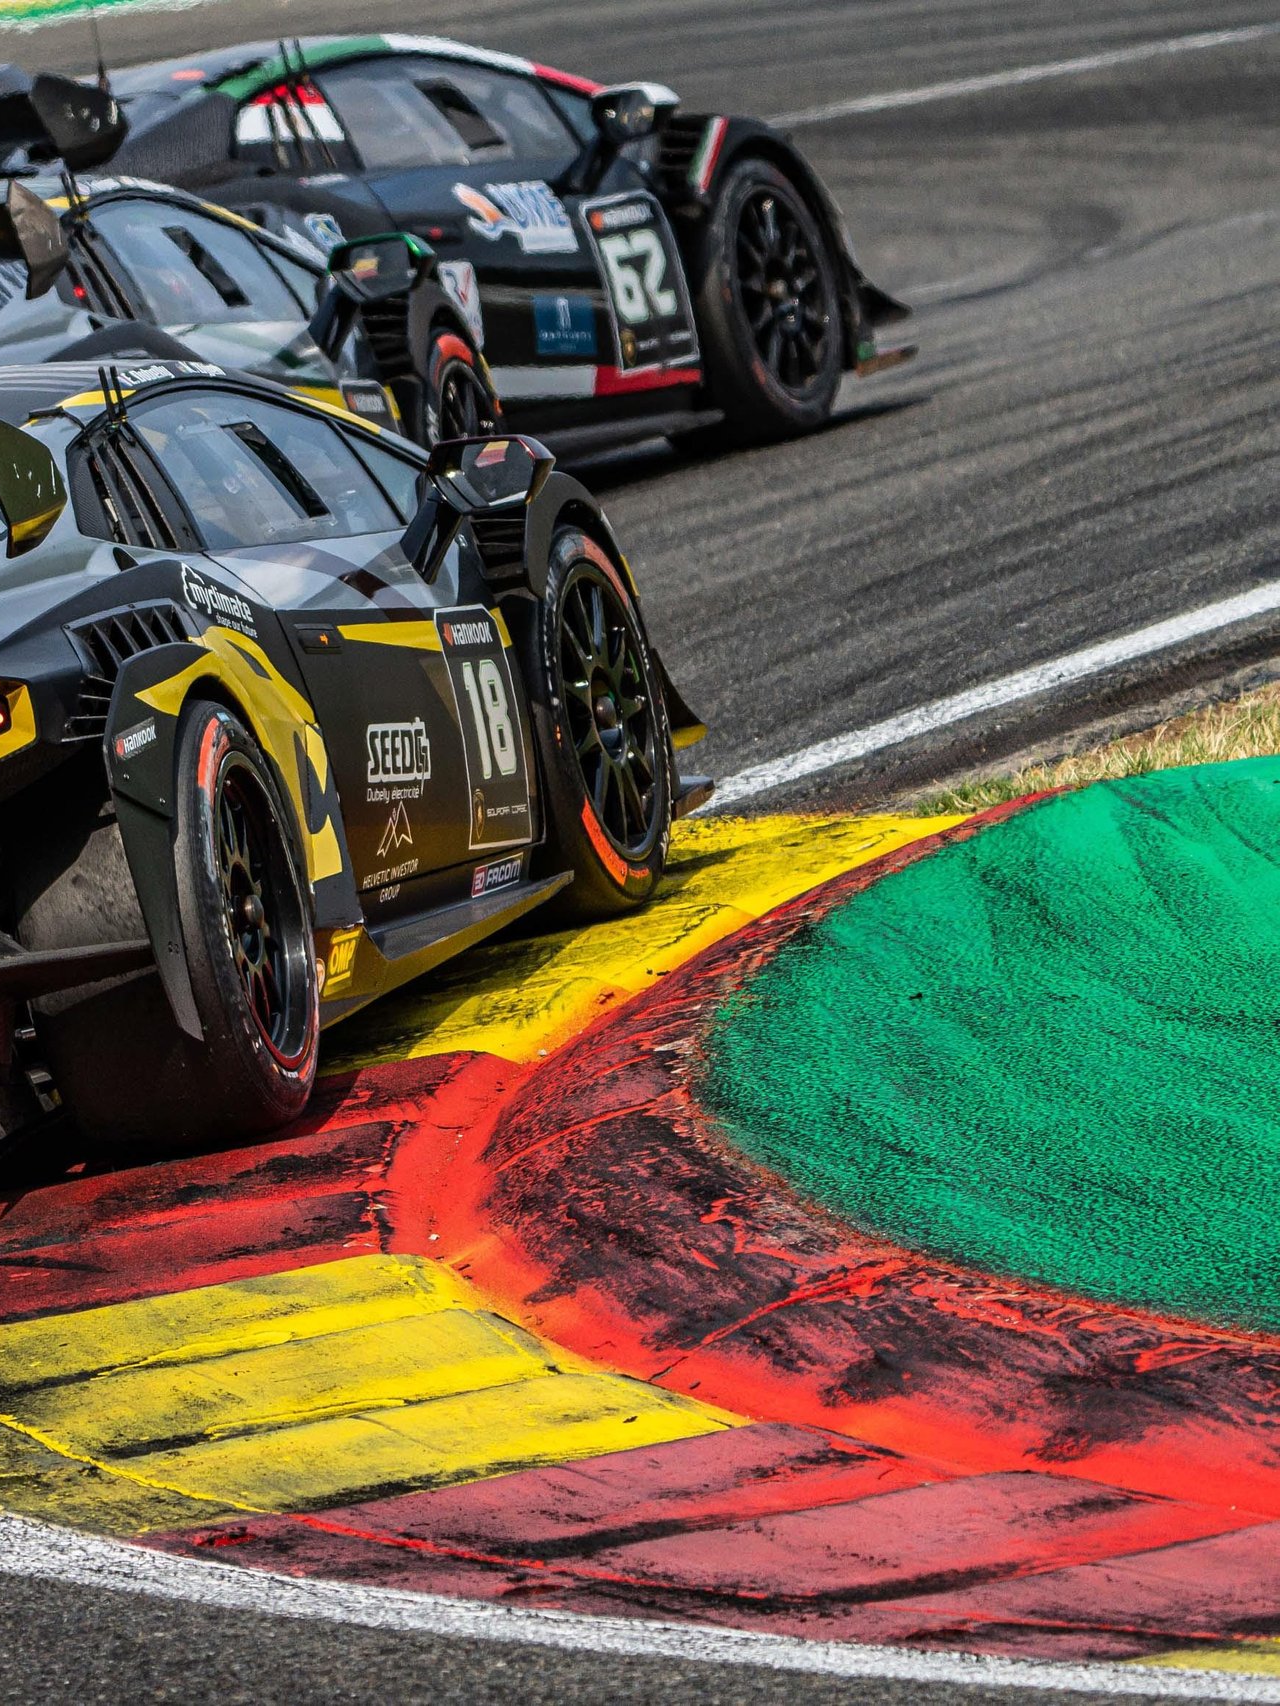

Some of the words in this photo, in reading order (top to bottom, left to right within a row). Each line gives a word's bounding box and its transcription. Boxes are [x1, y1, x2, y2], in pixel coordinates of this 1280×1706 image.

[599, 228, 677, 324] 62
[188, 581, 254, 623] myclimate
[462, 659, 517, 780] 18
[363, 868, 390, 890] HELVETIC
[390, 858, 419, 880] INVESTOR
[380, 884, 401, 903] GROUP
[330, 939, 356, 976] OMP
